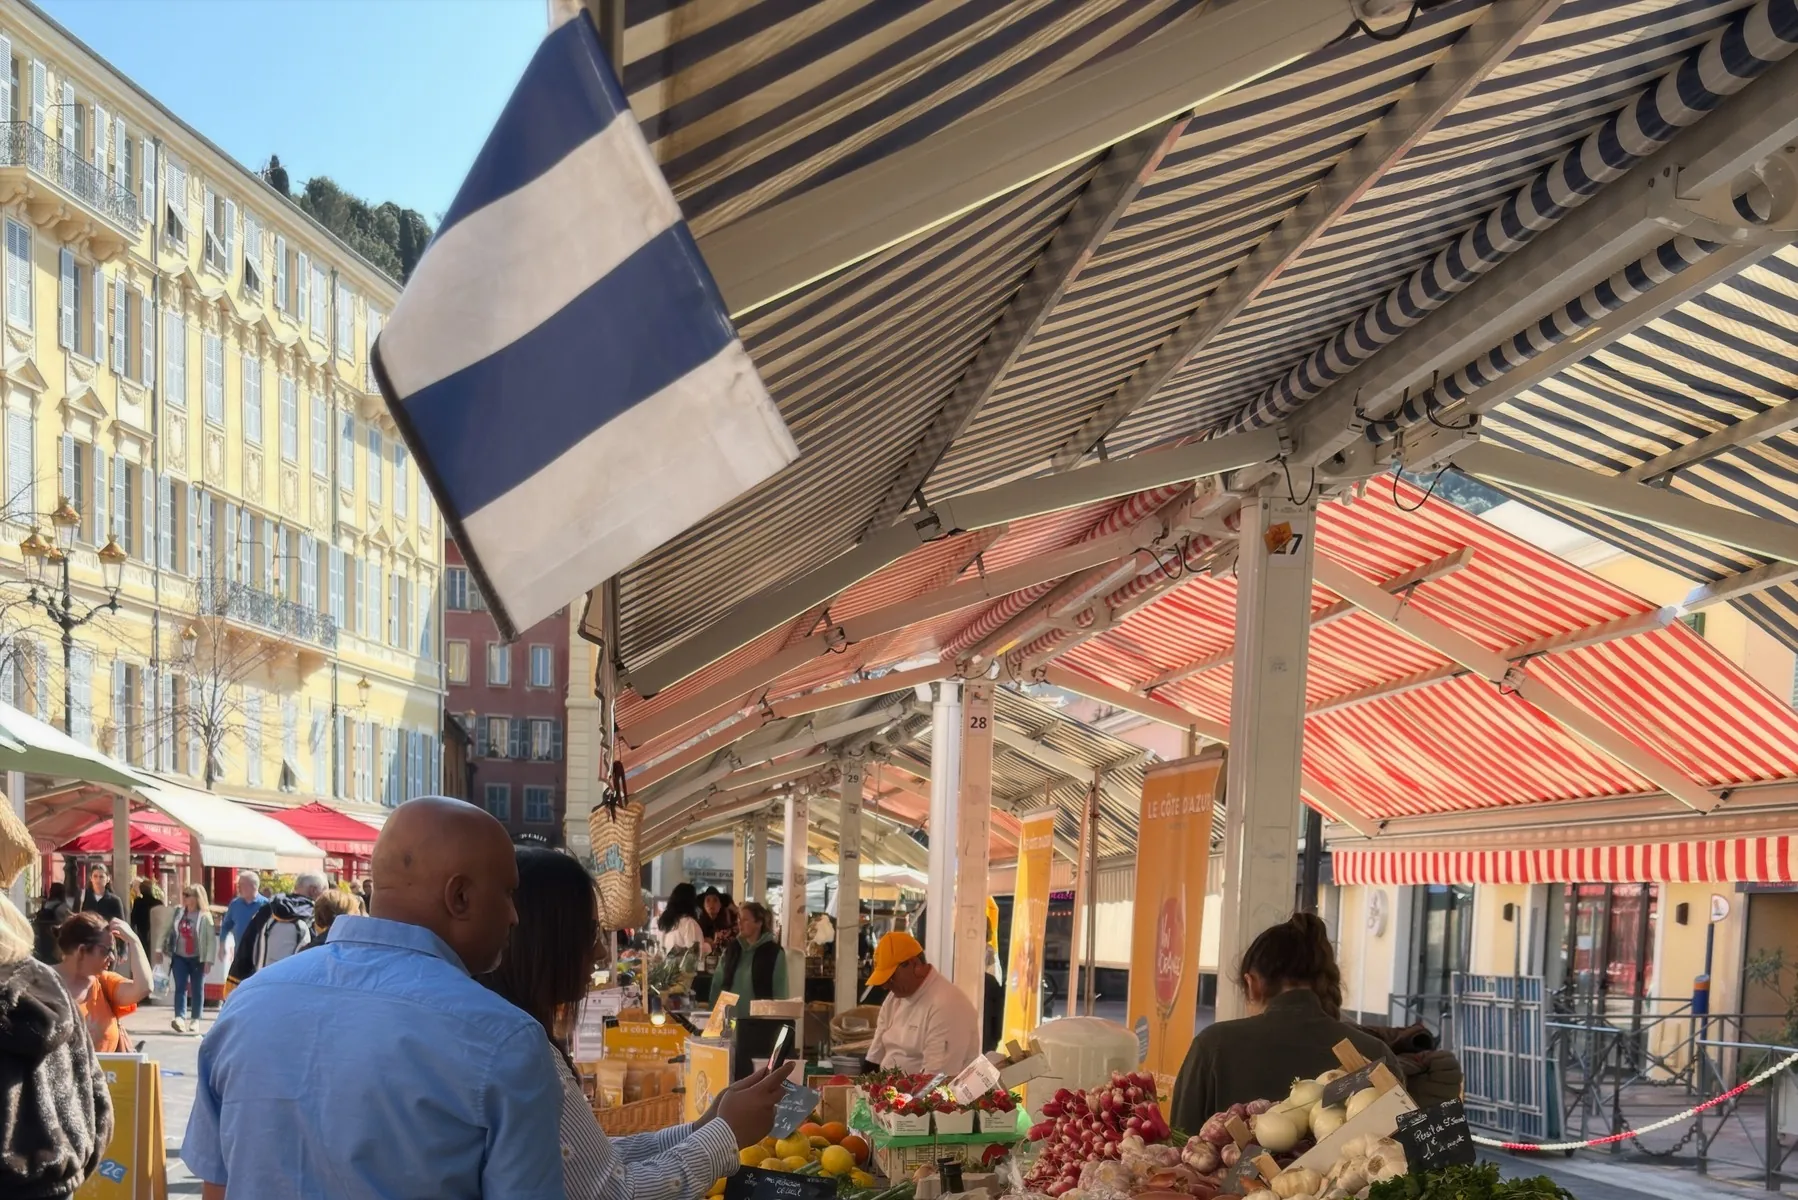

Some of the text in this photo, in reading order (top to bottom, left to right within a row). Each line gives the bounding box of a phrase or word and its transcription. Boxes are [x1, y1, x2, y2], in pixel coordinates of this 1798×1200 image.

[970, 716, 987, 729] 28
[848, 774, 859, 784] 29
[1147, 793, 1213, 819] LE CÔTE D'AZUR
[620, 1025, 628, 1033] LE
